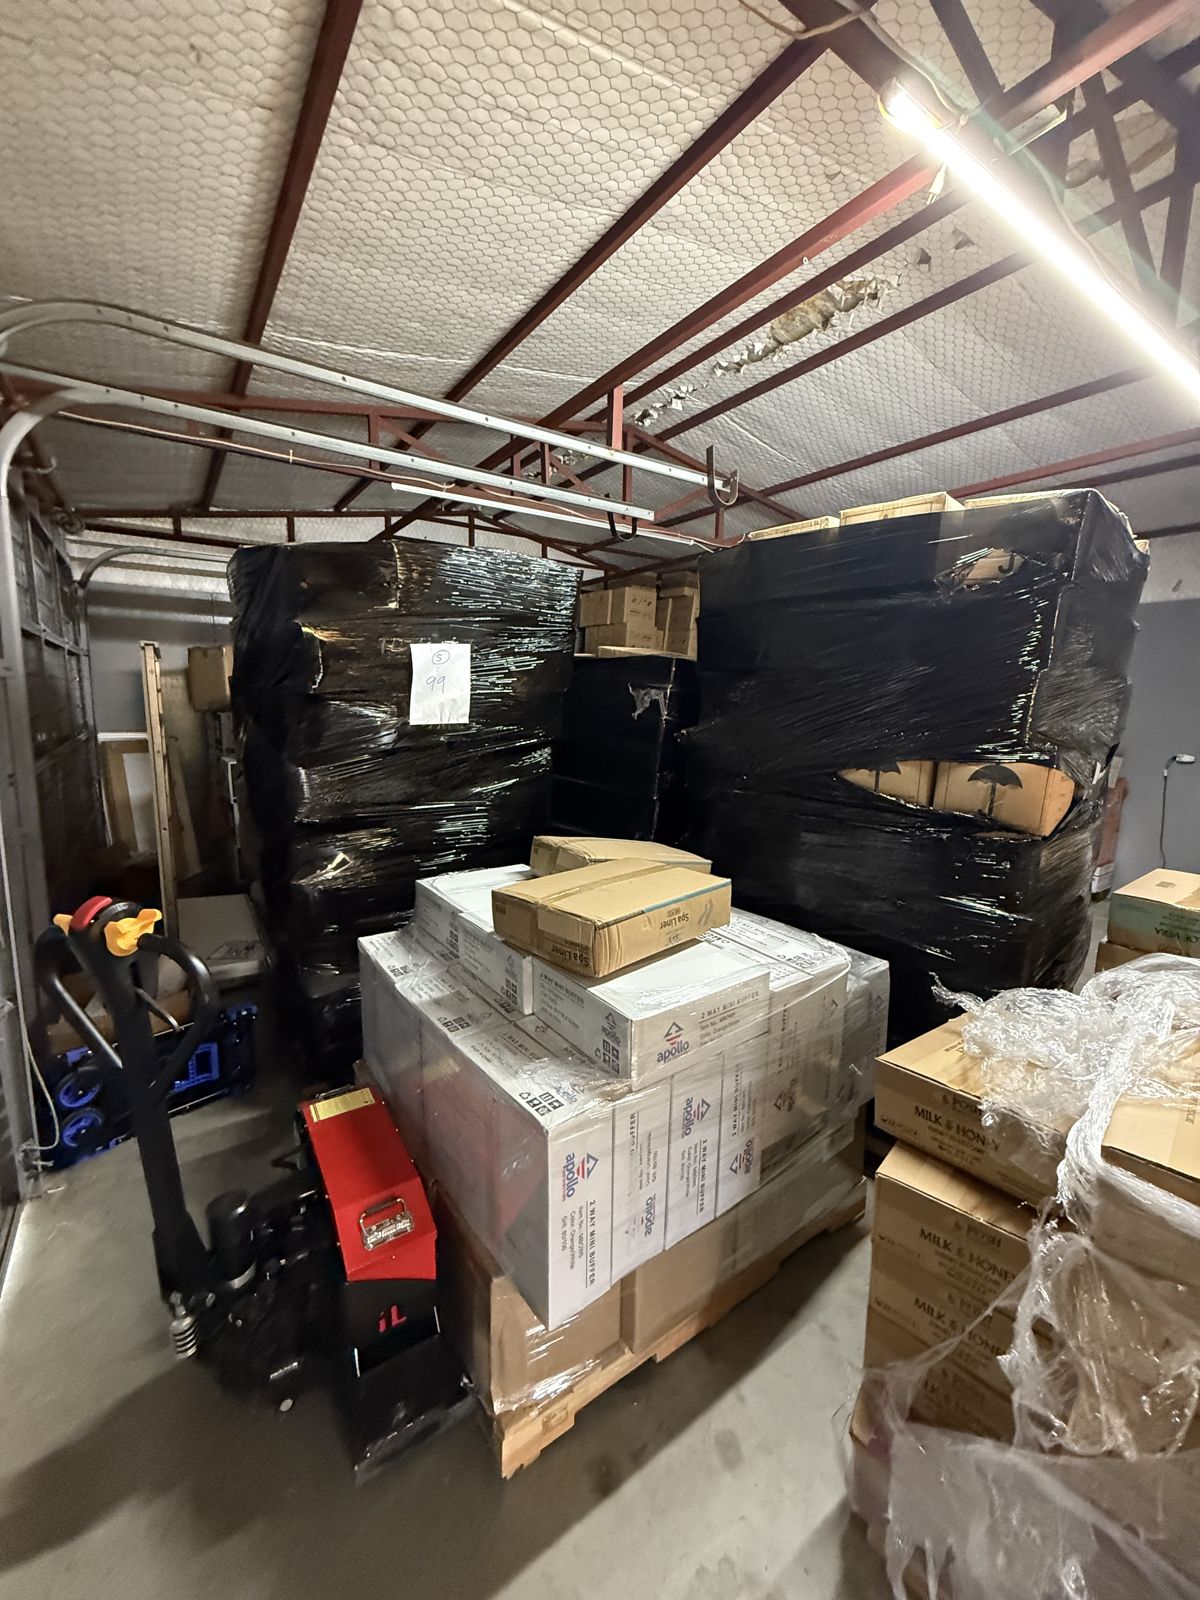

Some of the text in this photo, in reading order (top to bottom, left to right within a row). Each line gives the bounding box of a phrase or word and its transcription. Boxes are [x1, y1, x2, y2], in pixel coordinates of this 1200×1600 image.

[425, 675, 446, 694] 99
[706, 1006, 721, 1017] WAY
[656, 1039, 690, 1063] apollo
[684, 1097, 694, 1136] apollo
[914, 1105, 943, 1127] MILK
[945, 1119, 954, 1131] &
[743, 1139, 753, 1174] apollo
[563, 1152, 579, 1198] apollo
[644, 1196, 654, 1237] apollo
[919, 1228, 952, 1251] MILK
[914, 1297, 946, 1324] MILK
